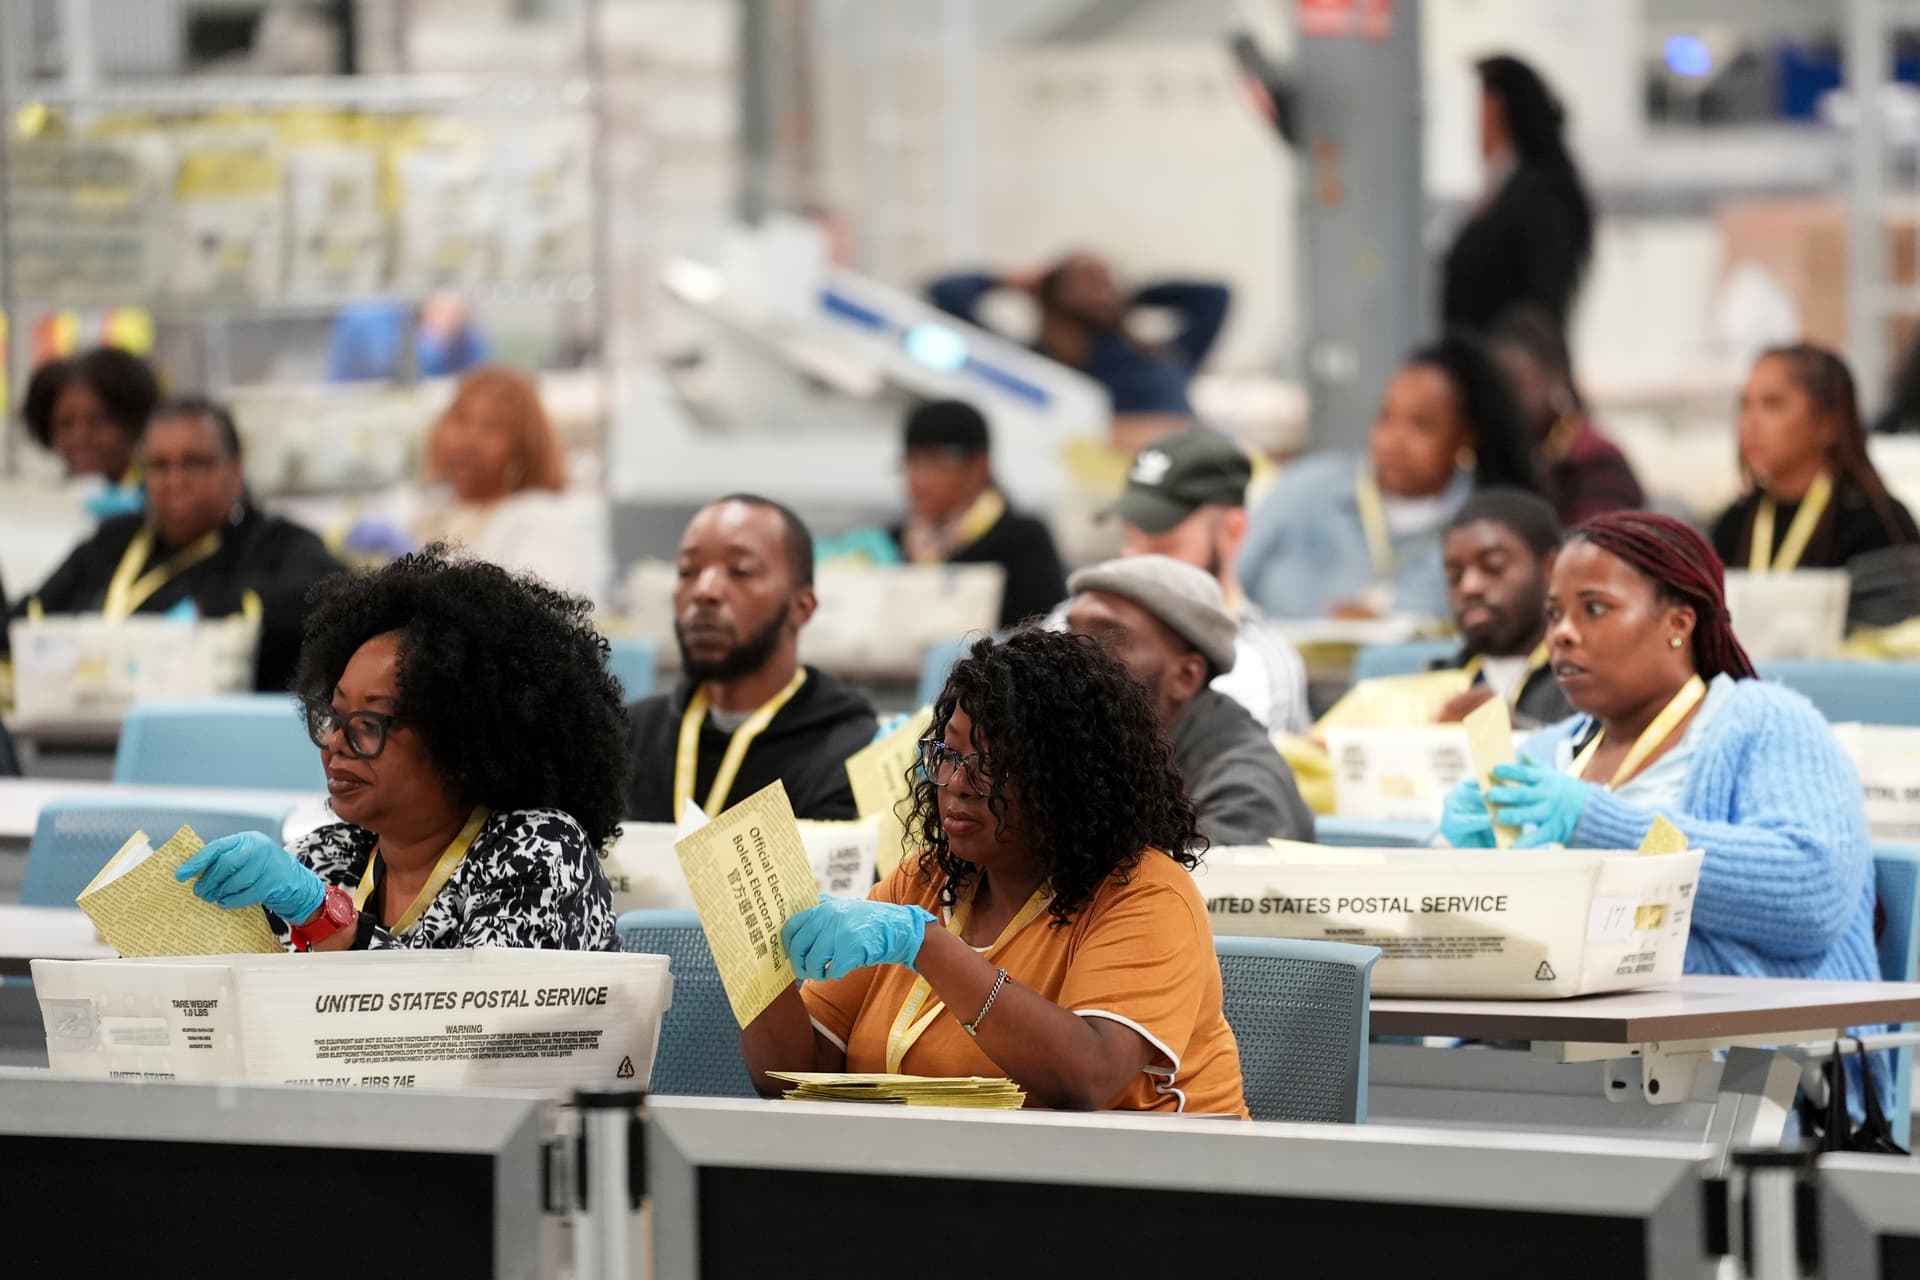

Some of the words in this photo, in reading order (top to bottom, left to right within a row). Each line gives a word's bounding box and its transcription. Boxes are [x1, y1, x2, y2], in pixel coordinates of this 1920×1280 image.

[749, 826, 774, 872] Official
[767, 873, 786, 924] Election
[732, 834, 754, 877] Boleta
[749, 877, 777, 933] Electoral
[769, 933, 782, 972] Oficial
[1258, 897, 1331, 914] STATES
[1337, 897, 1414, 913] POSTAL
[1420, 895, 1508, 913] SERVICE
[172, 1000, 191, 1008] TARE
[191, 1000, 218, 1008] WEIGHT
[315, 994, 384, 1012] UNITED
[388, 991, 457, 1011] STATES
[461, 990, 530, 1008] POSTAL
[534, 987, 608, 1006] SERVICE
[445, 1024, 483, 1034] WARNING
[393, 1074, 415, 1088] 74E
